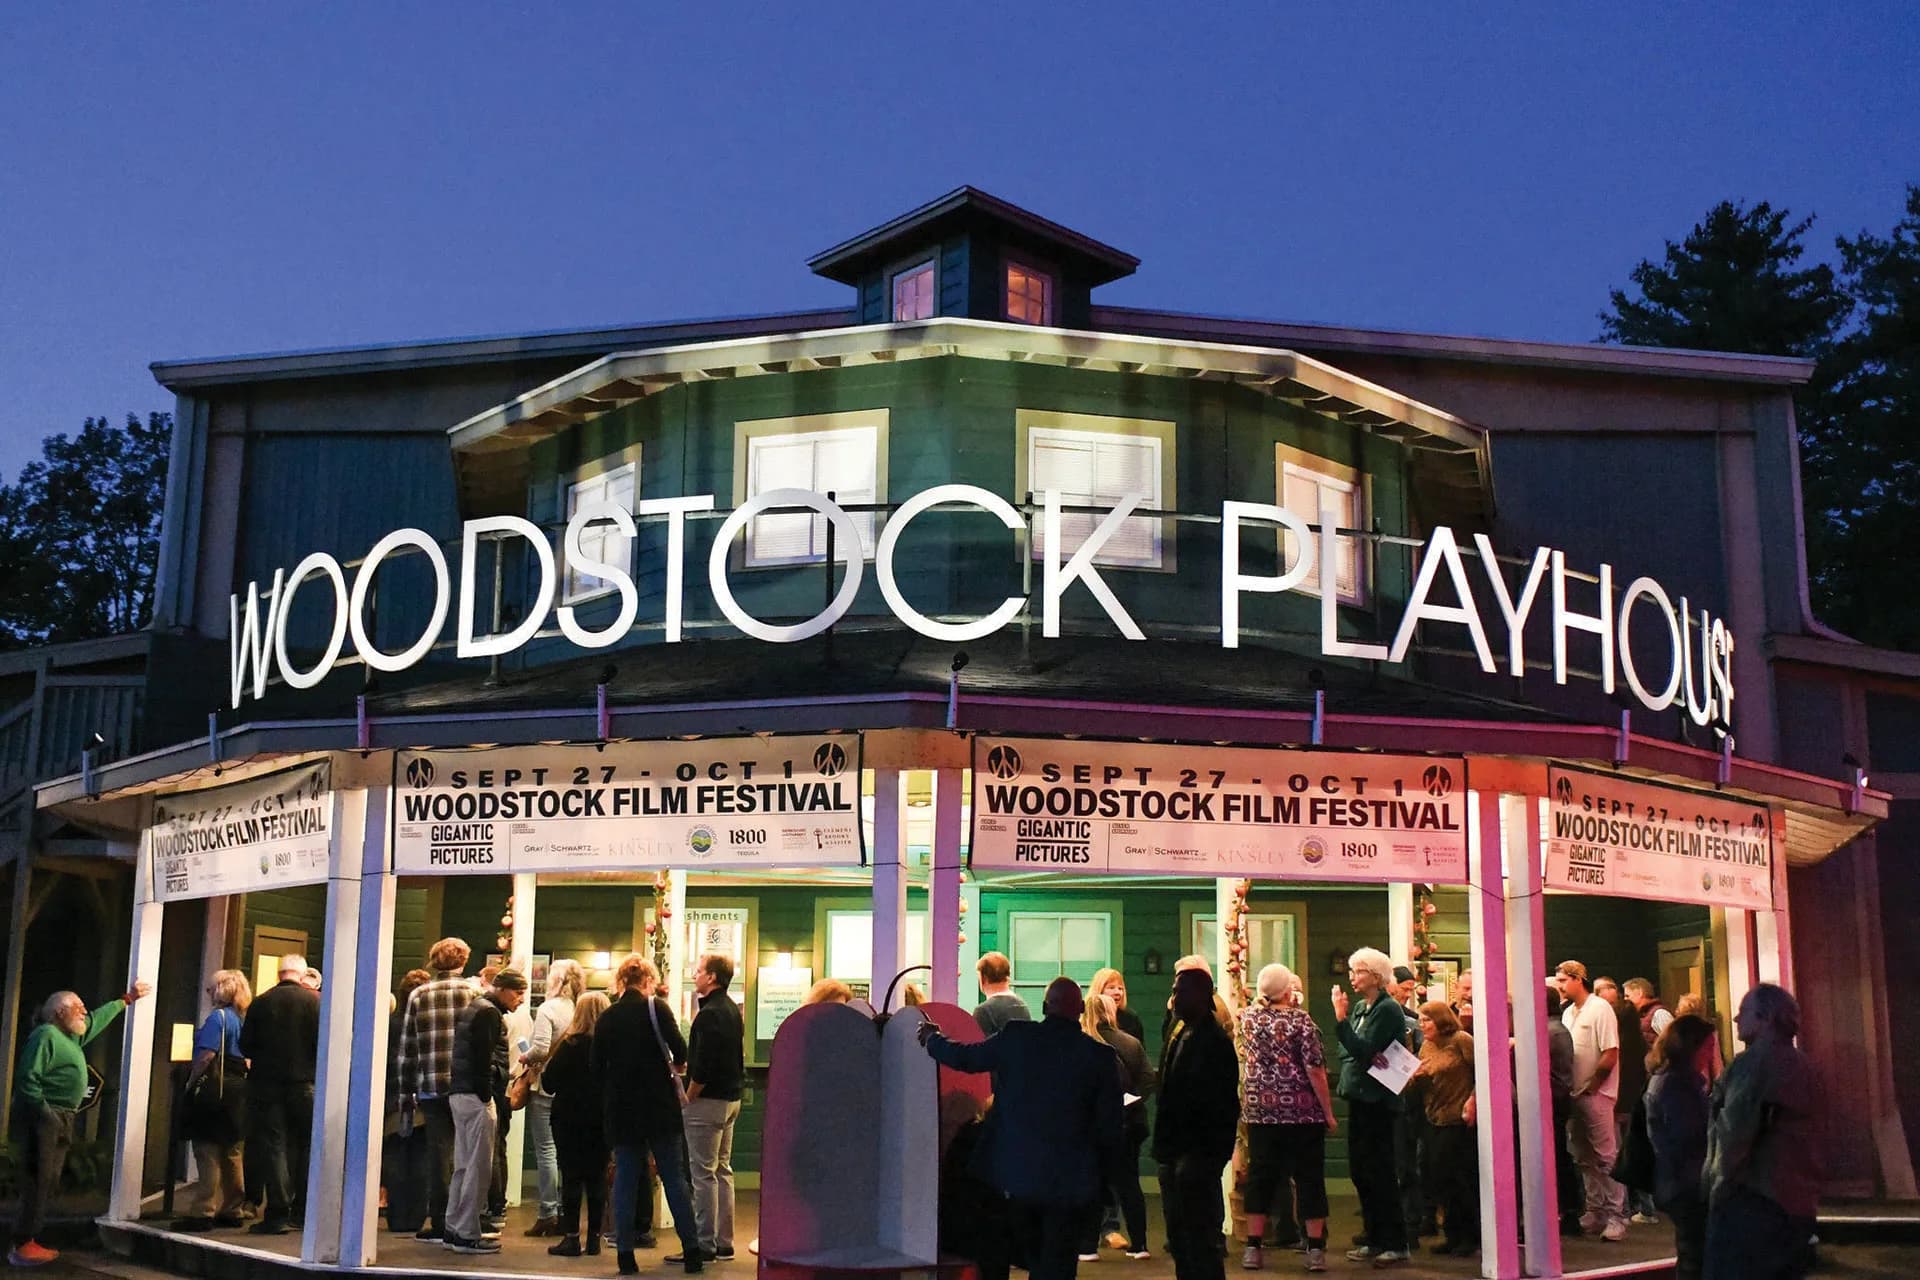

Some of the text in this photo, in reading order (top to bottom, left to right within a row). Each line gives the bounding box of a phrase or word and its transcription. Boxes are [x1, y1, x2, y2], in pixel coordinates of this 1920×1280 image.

[231, 484, 1147, 709] WOODSTOCK
[451, 768, 549, 789] SEPT
[572, 766, 617, 785] 27
[676, 761, 757, 782] OCT
[783, 760, 793, 778] 1
[1042, 763, 1152, 785] SEPT
[1180, 769, 1226, 788] 27
[1288, 773, 1368, 795] OCT
[1393, 779, 1403, 797] 1
[211, 805, 233, 823] 27
[251, 794, 285, 815] OCT
[296, 790, 302, 806] 1
[405, 782, 852, 821] WOODSTOCK FILM FESTIVAL
[985, 785, 1460, 831] WOODSTOCK FILM FESTIVAL
[1582, 794, 1635, 819] SEPT
[1647, 806, 1668, 824] 27
[1695, 815, 1731, 835] OCT
[1740, 822, 1745, 837] 1
[155, 806, 326, 858] WOODSTOCK FILM FESTIVAL
[430, 823, 494, 842] GIGANTIC
[729, 829, 767, 845] 1800
[1017, 819, 1091, 839] GIGANTIC
[1555, 811, 1767, 867] WOODSTOCK FILM FESTIVAL
[430, 847, 494, 865] PICTURES
[1015, 844, 1090, 864] PICTURES
[1341, 842, 1378, 858] 1800
[1569, 843, 1606, 864] GIGANTIC
[165, 858, 188, 875] GIGANTIC
[1567, 866, 1605, 885] PICTURES
[165, 878, 189, 894] PICTURES
[686, 910, 739, 921] shments
